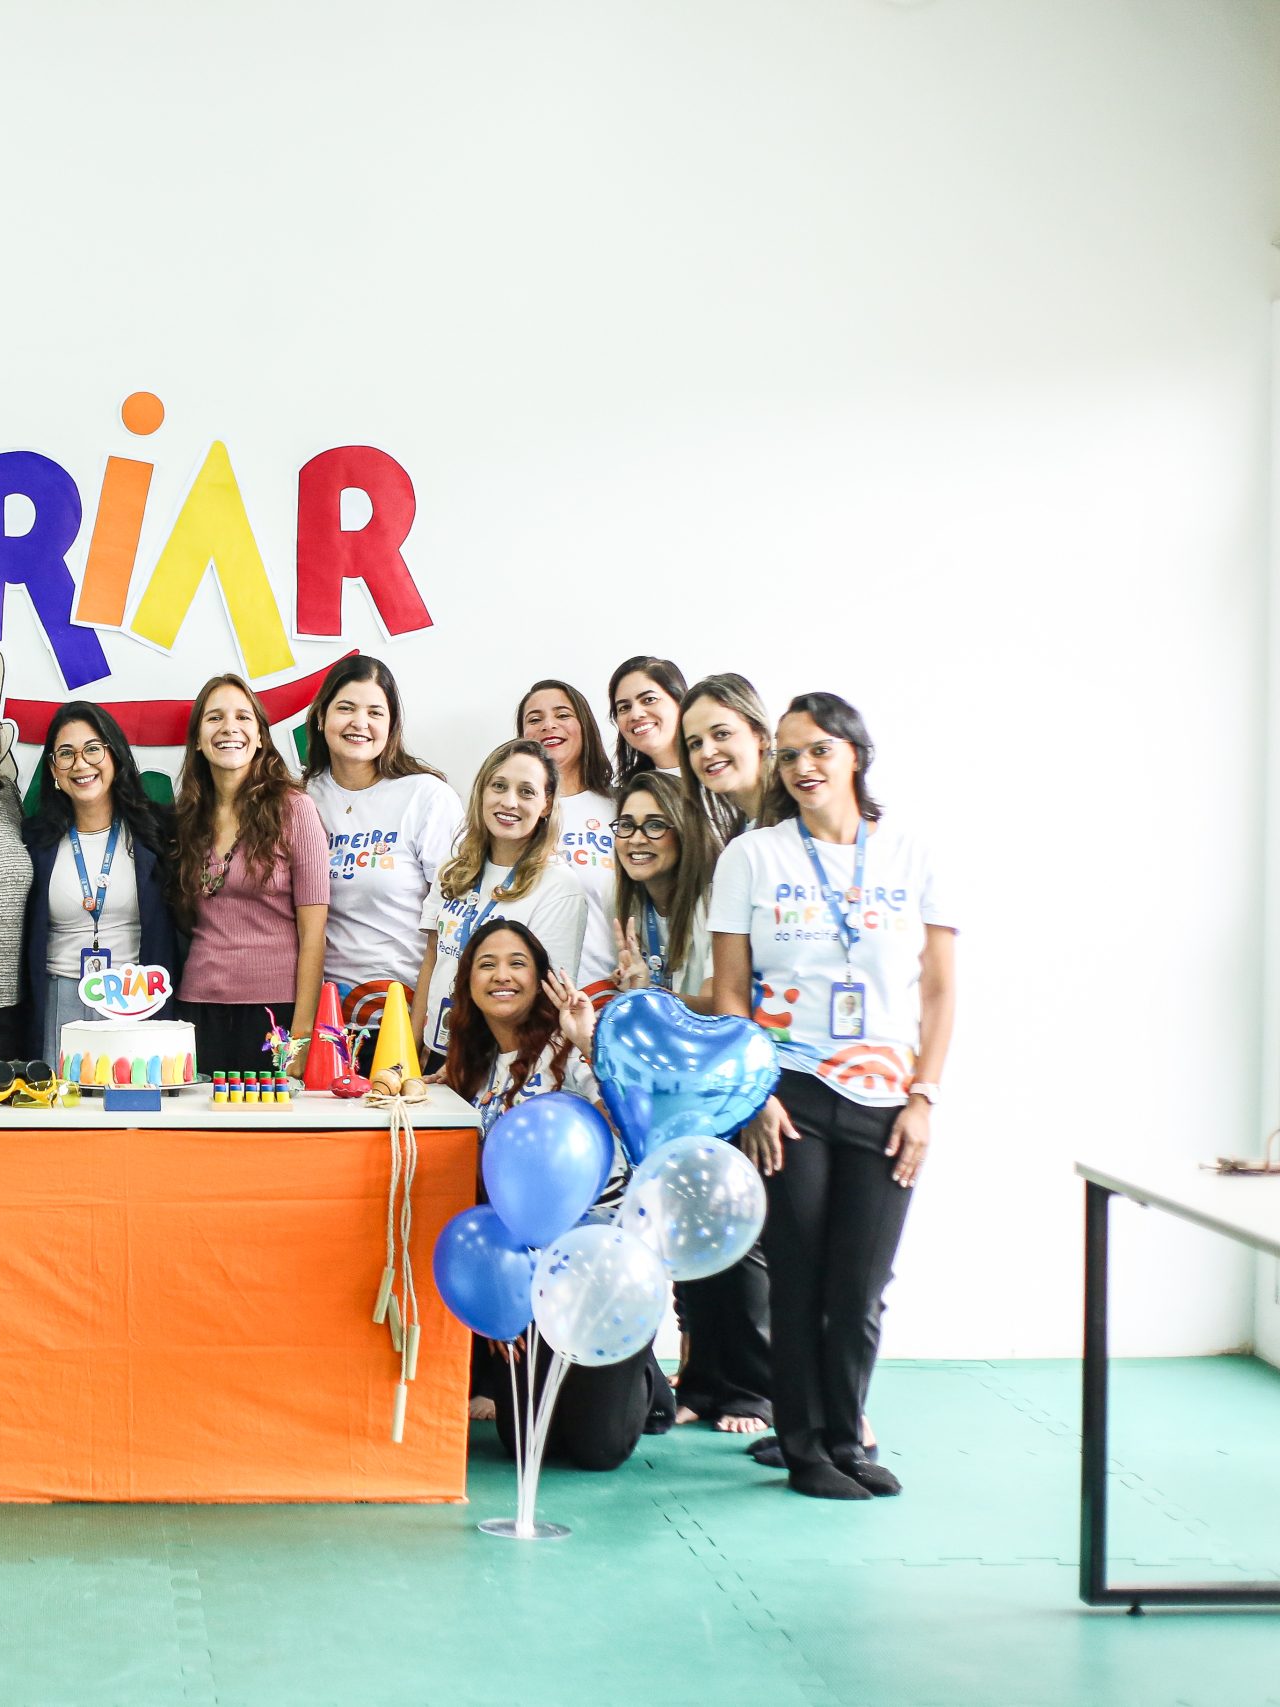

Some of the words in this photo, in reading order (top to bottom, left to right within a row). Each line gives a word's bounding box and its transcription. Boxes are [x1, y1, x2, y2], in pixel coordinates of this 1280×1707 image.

[774, 929, 790, 941] do
[795, 929, 839, 941] Recife
[83, 968, 167, 1010] CRiAR
